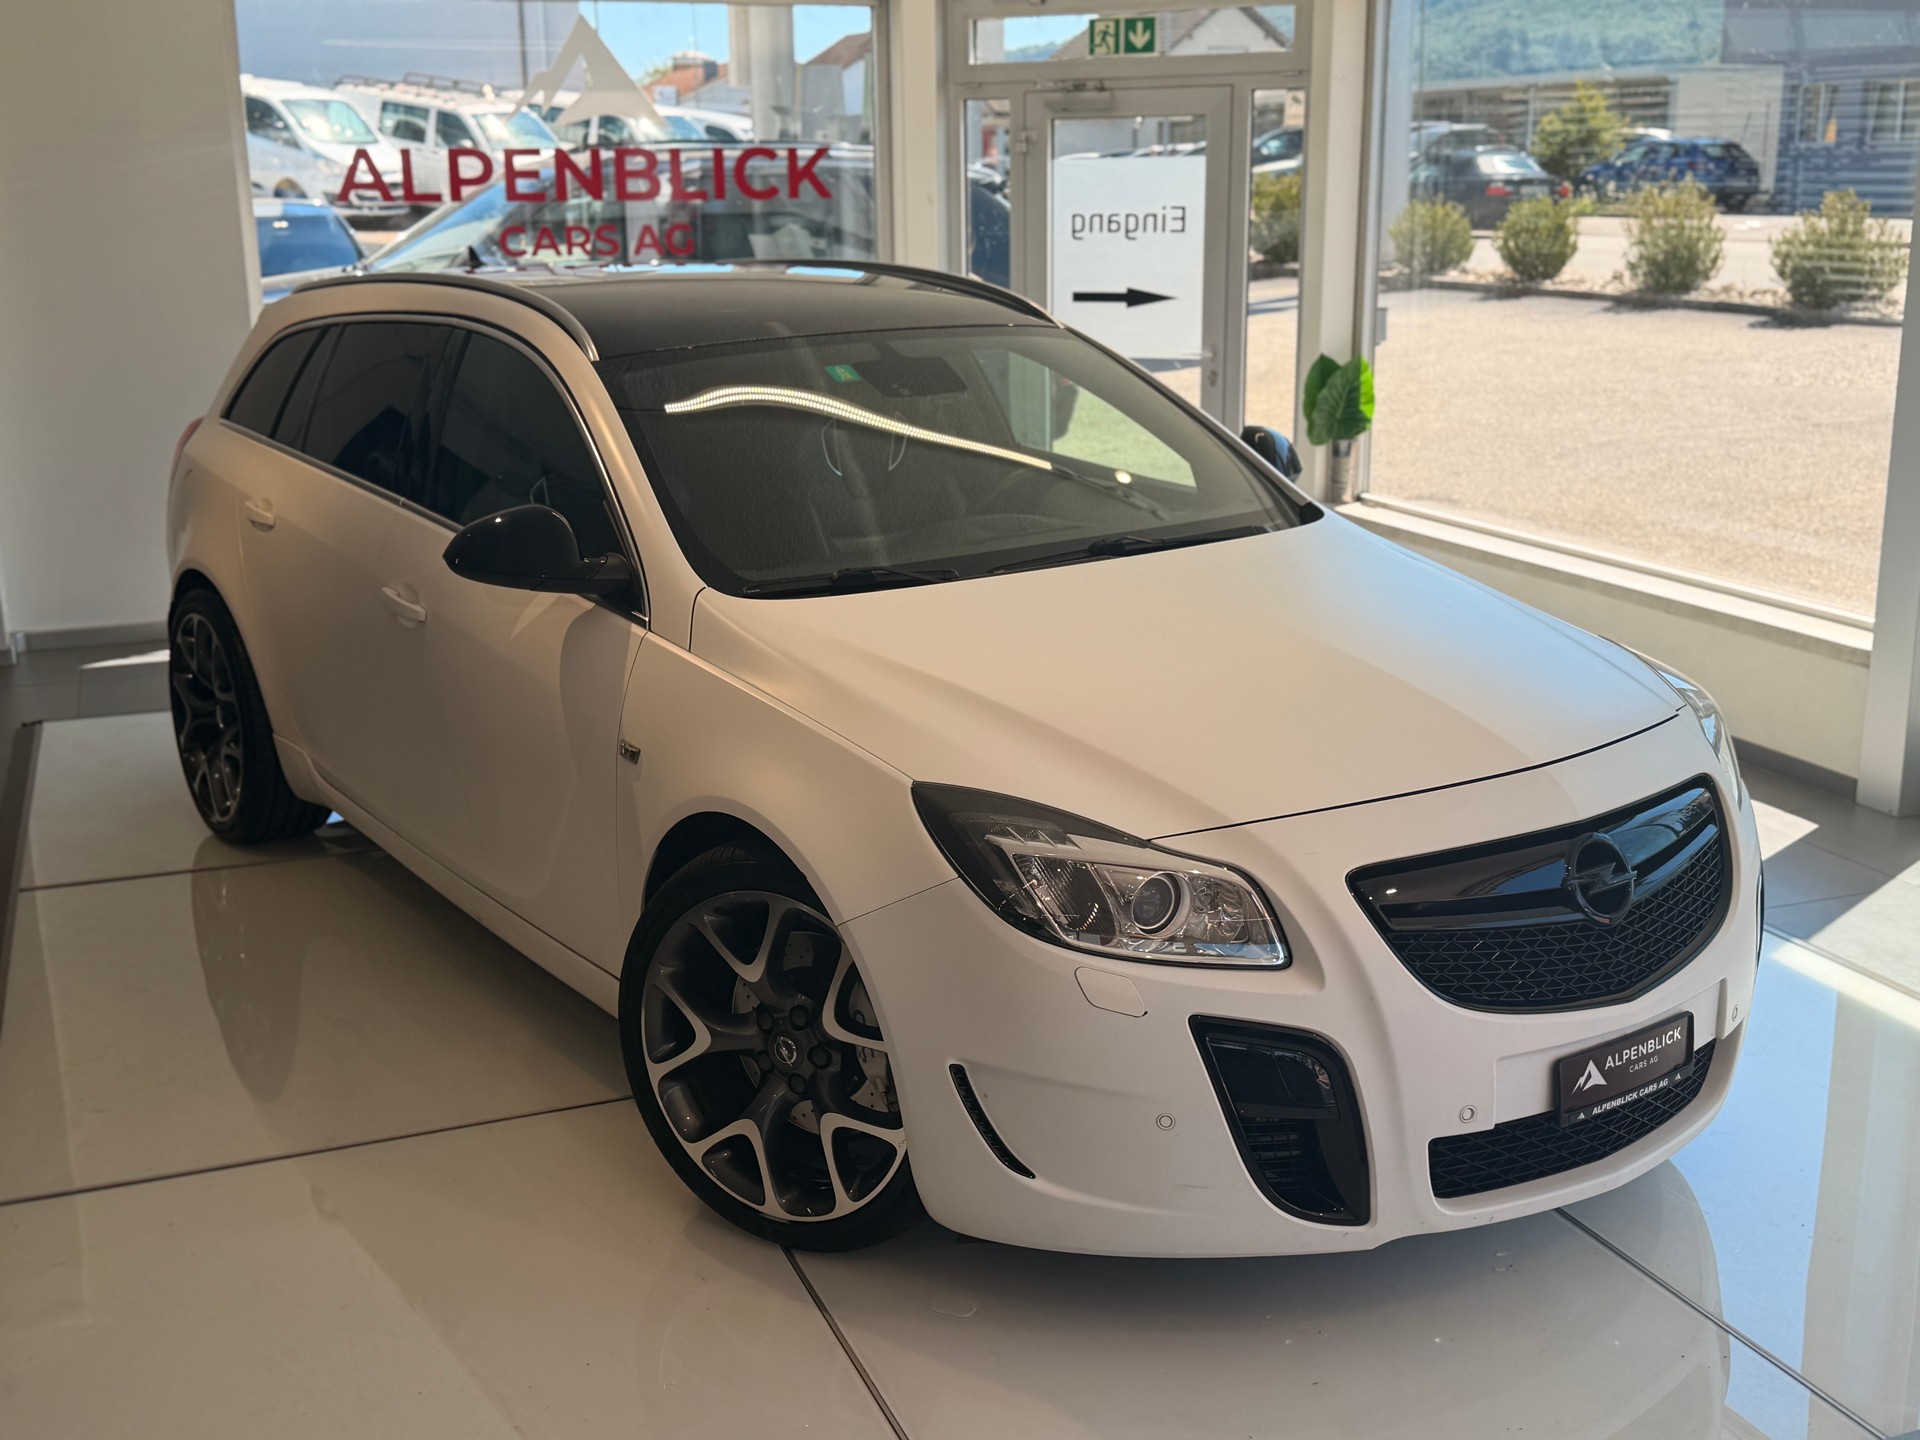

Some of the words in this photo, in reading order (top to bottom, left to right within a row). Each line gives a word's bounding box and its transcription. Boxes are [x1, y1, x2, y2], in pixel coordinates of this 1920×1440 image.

[338, 147, 833, 202] ALPENBLICK
[499, 224, 621, 257] CARS
[634, 223, 695, 257] AG
[1604, 1026, 1682, 1070] ALPENBLICK
[1629, 1060, 1648, 1073] CARS
[1649, 1055, 1659, 1066] AG
[1592, 1091, 1638, 1115] ALPENBLICK
[1639, 1082, 1658, 1097] CARS
[1658, 1078, 1669, 1089] AG
